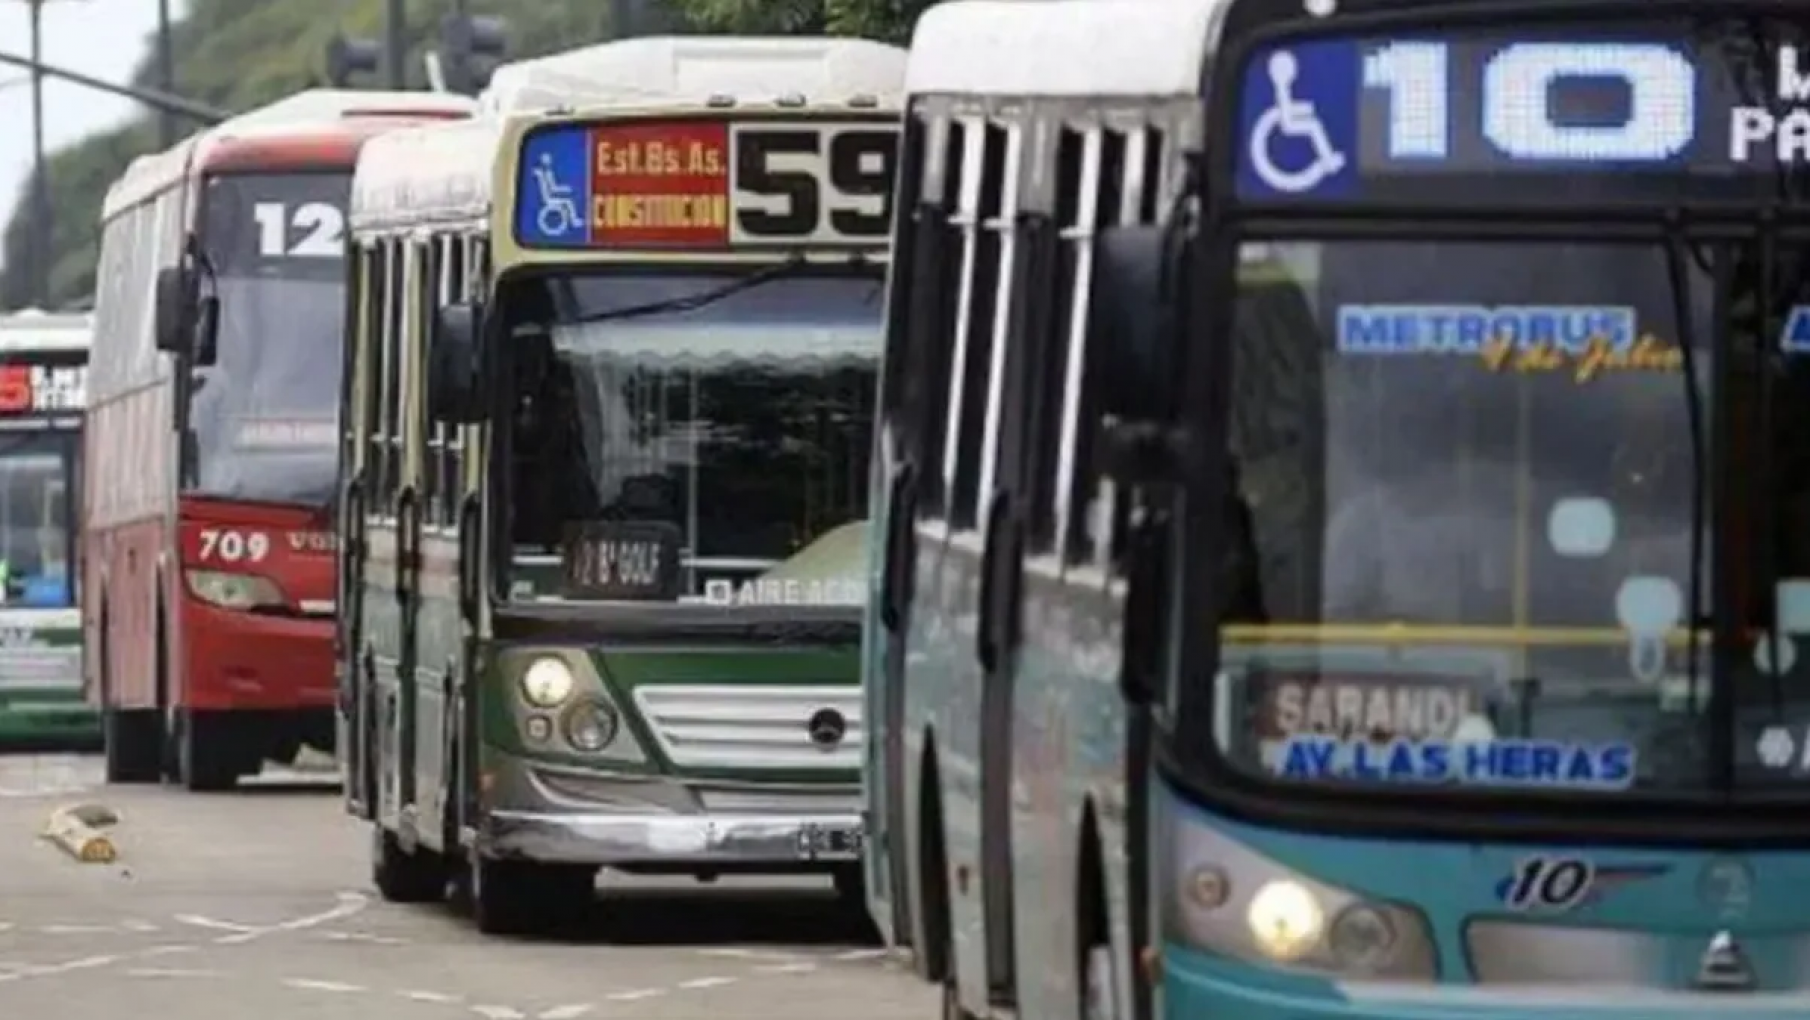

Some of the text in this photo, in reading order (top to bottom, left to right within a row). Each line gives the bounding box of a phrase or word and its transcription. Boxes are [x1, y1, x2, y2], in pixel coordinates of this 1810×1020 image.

[1364, 41, 1695, 160] 10
[736, 131, 900, 236] 59
[254, 203, 344, 256] 12
[1341, 309, 1634, 350] METROBUS
[199, 531, 270, 562] 709
[738, 579, 801, 606] AIRE
[1275, 682, 1471, 738] SARANDI
[1354, 741, 1449, 777] LAS
[1465, 745, 1633, 782] HERAS
[1512, 858, 1590, 906] 10
